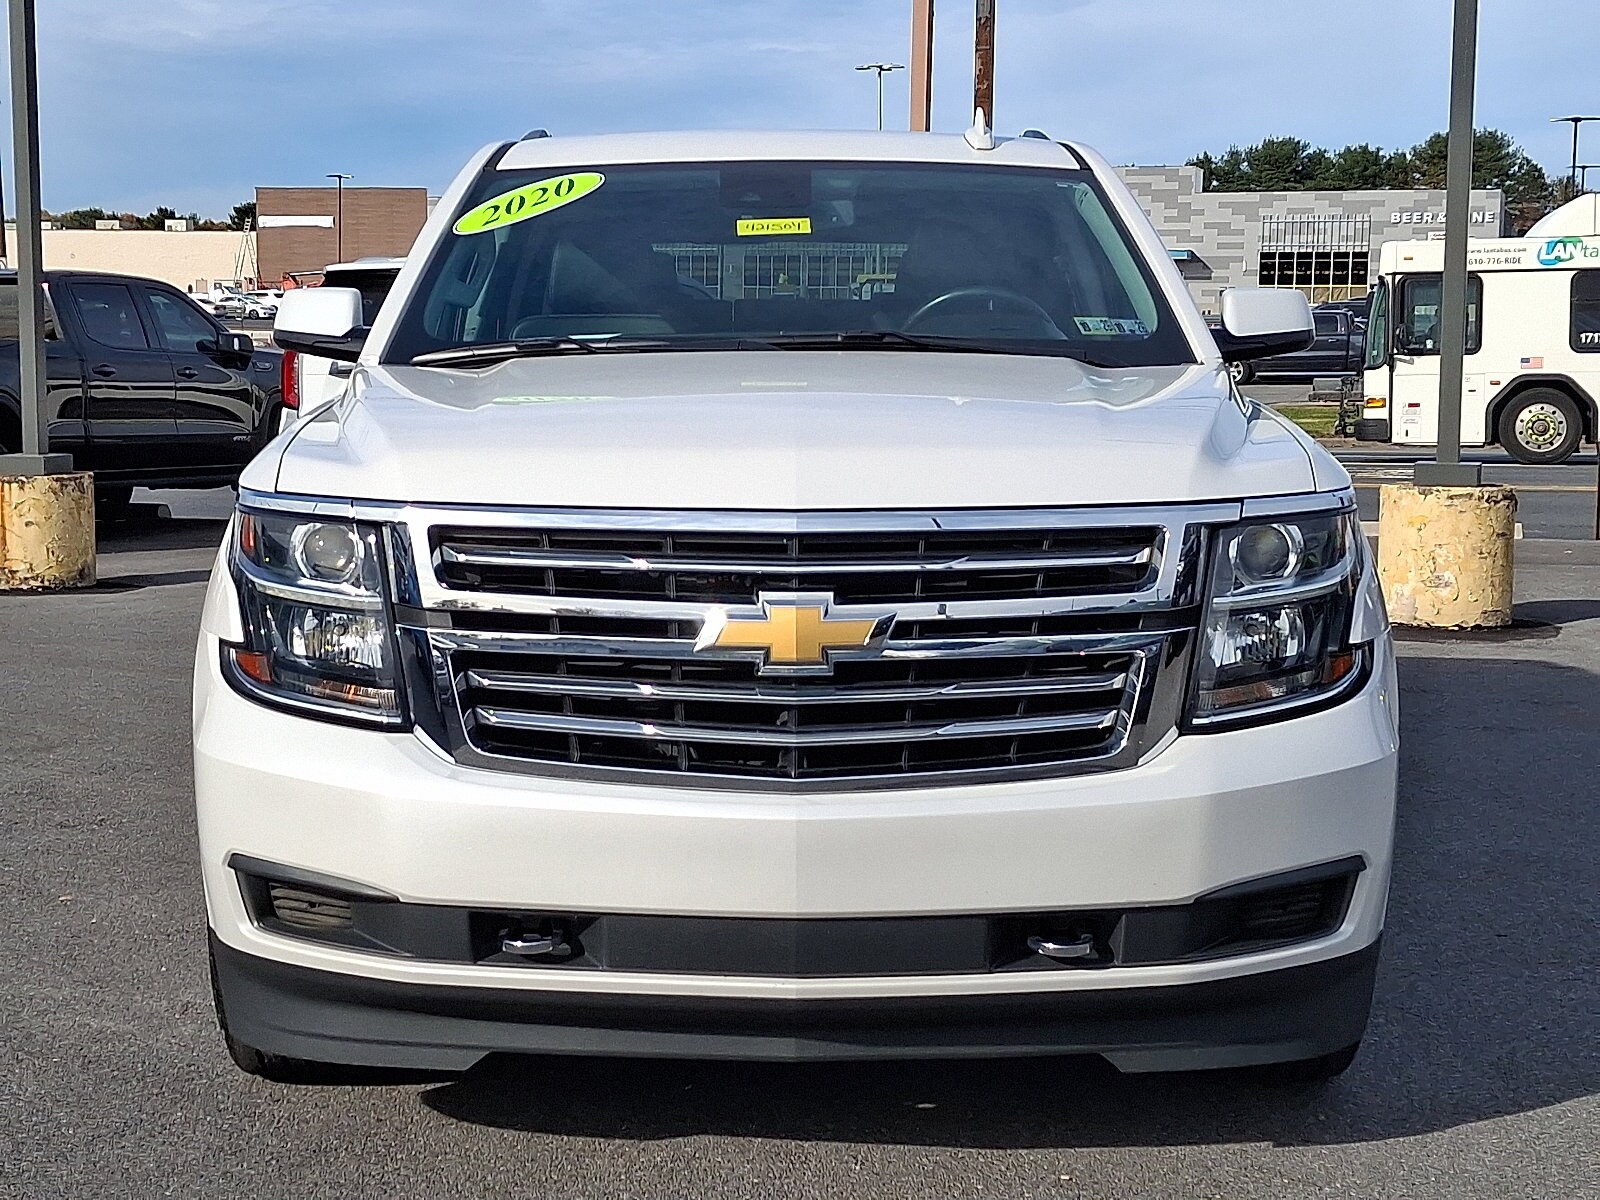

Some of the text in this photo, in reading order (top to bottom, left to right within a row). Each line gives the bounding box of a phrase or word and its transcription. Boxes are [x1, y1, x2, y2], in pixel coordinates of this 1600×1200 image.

[482, 178, 575, 226] 2020
[1391, 212, 1434, 224] BEER
[1468, 257, 1522, 266] 610-776-RIDE
[1580, 332, 1600, 343] 171
